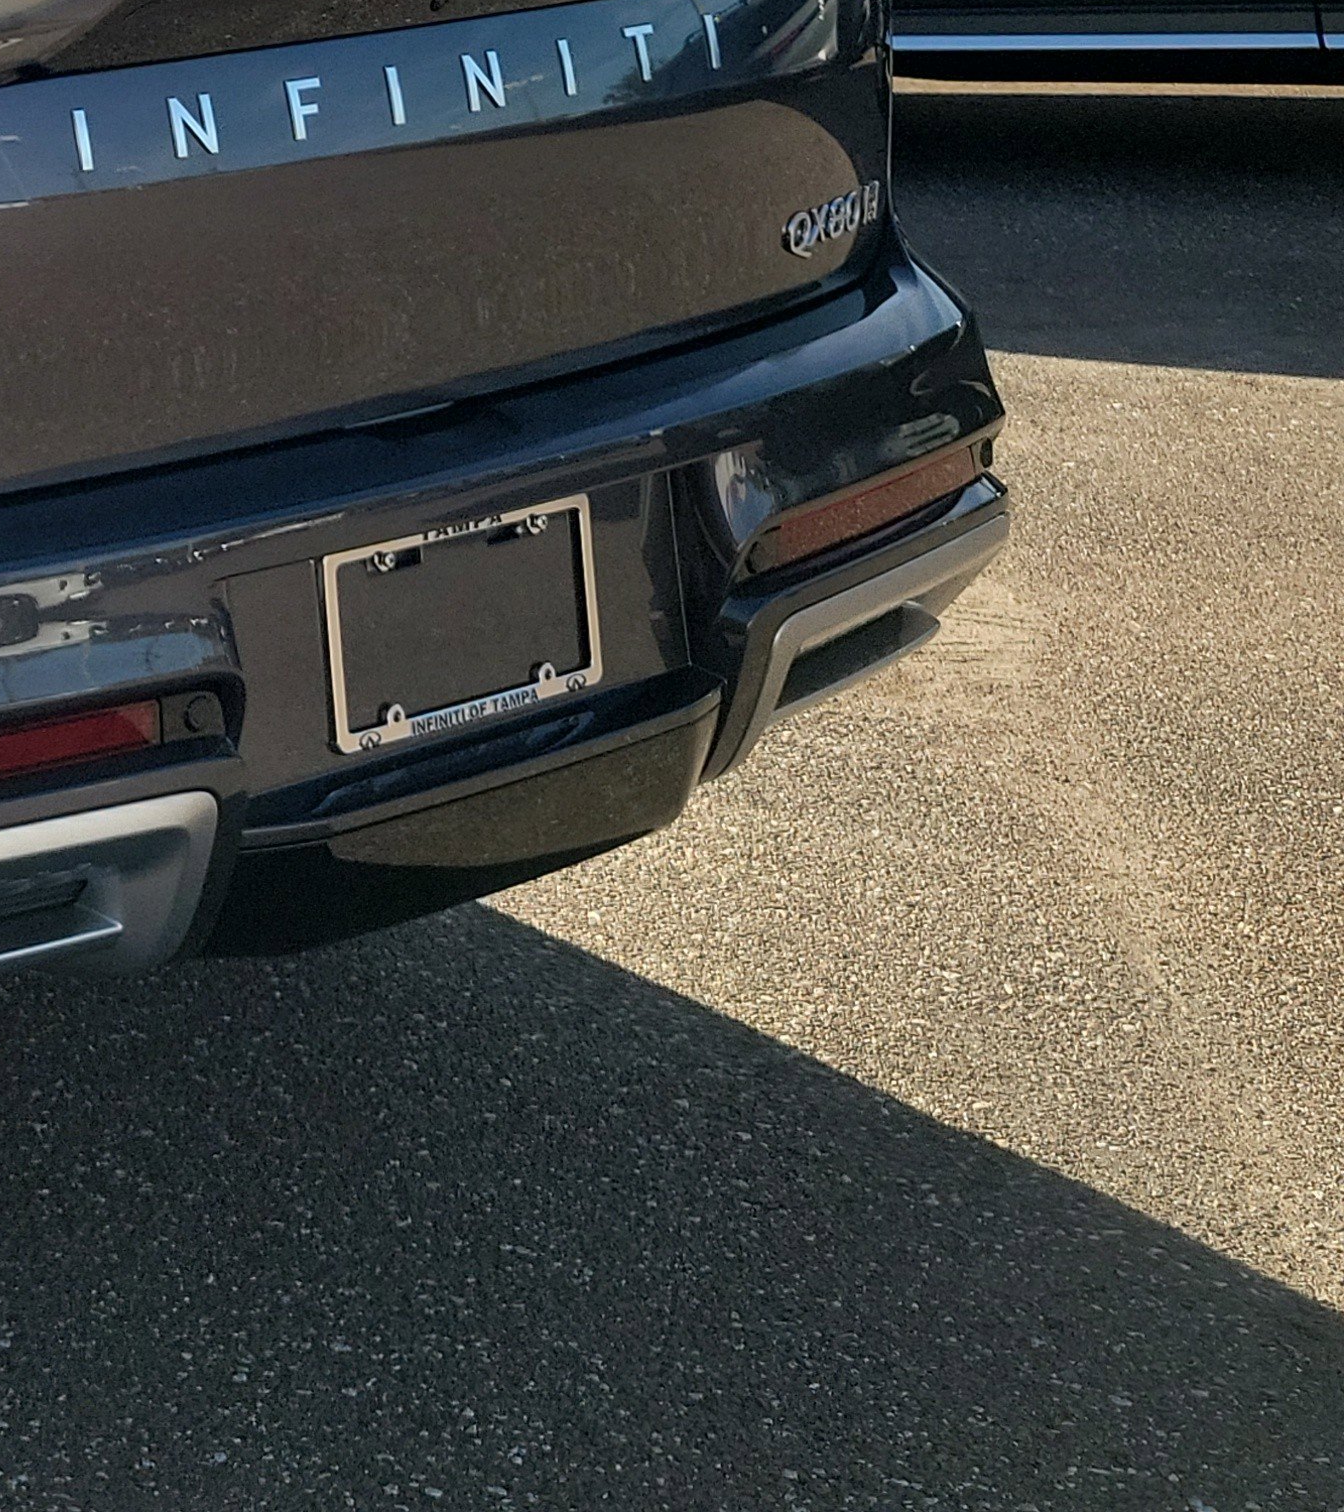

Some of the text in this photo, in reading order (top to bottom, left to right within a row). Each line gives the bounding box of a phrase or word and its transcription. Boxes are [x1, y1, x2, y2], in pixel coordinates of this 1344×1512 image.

[71, 13, 721, 172] INFINITI
[784, 189, 861, 259] QX80
[411, 687, 540, 735] INFINITI OF TAMPA
